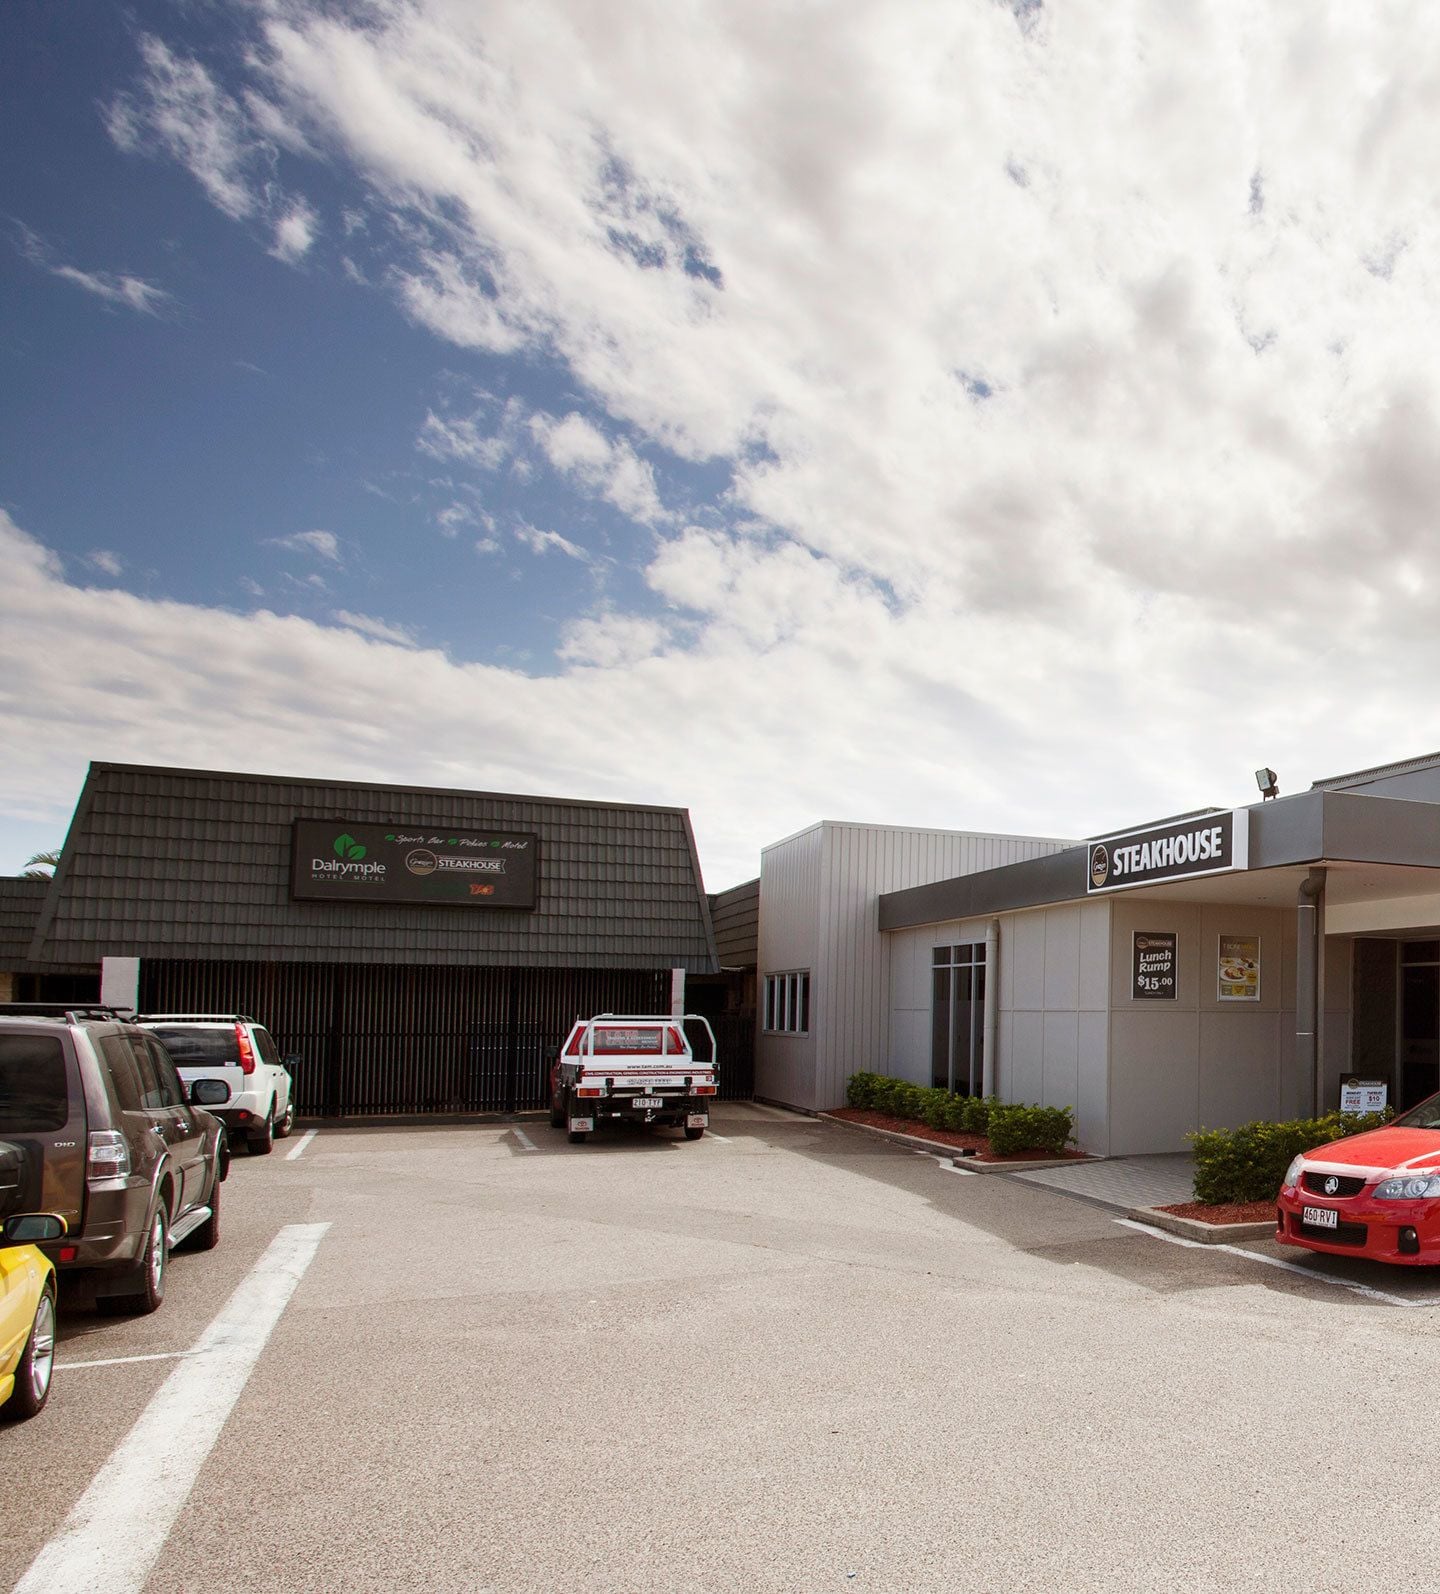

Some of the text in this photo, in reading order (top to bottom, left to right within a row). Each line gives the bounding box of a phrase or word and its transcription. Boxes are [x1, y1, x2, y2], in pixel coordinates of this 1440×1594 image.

[395, 834, 445, 845] Sports Bar
[459, 838, 488, 848] Pokies
[501, 841, 529, 850] Motel
[1112, 826, 1223, 877] STEAKHOUSE
[312, 858, 386, 876] Dalrymple
[438, 859, 501, 870] STEAKHOUSE
[1140, 950, 1172, 963] Lunch
[1139, 961, 1171, 973] Rump
[1137, 974, 1173, 990] $15.00
